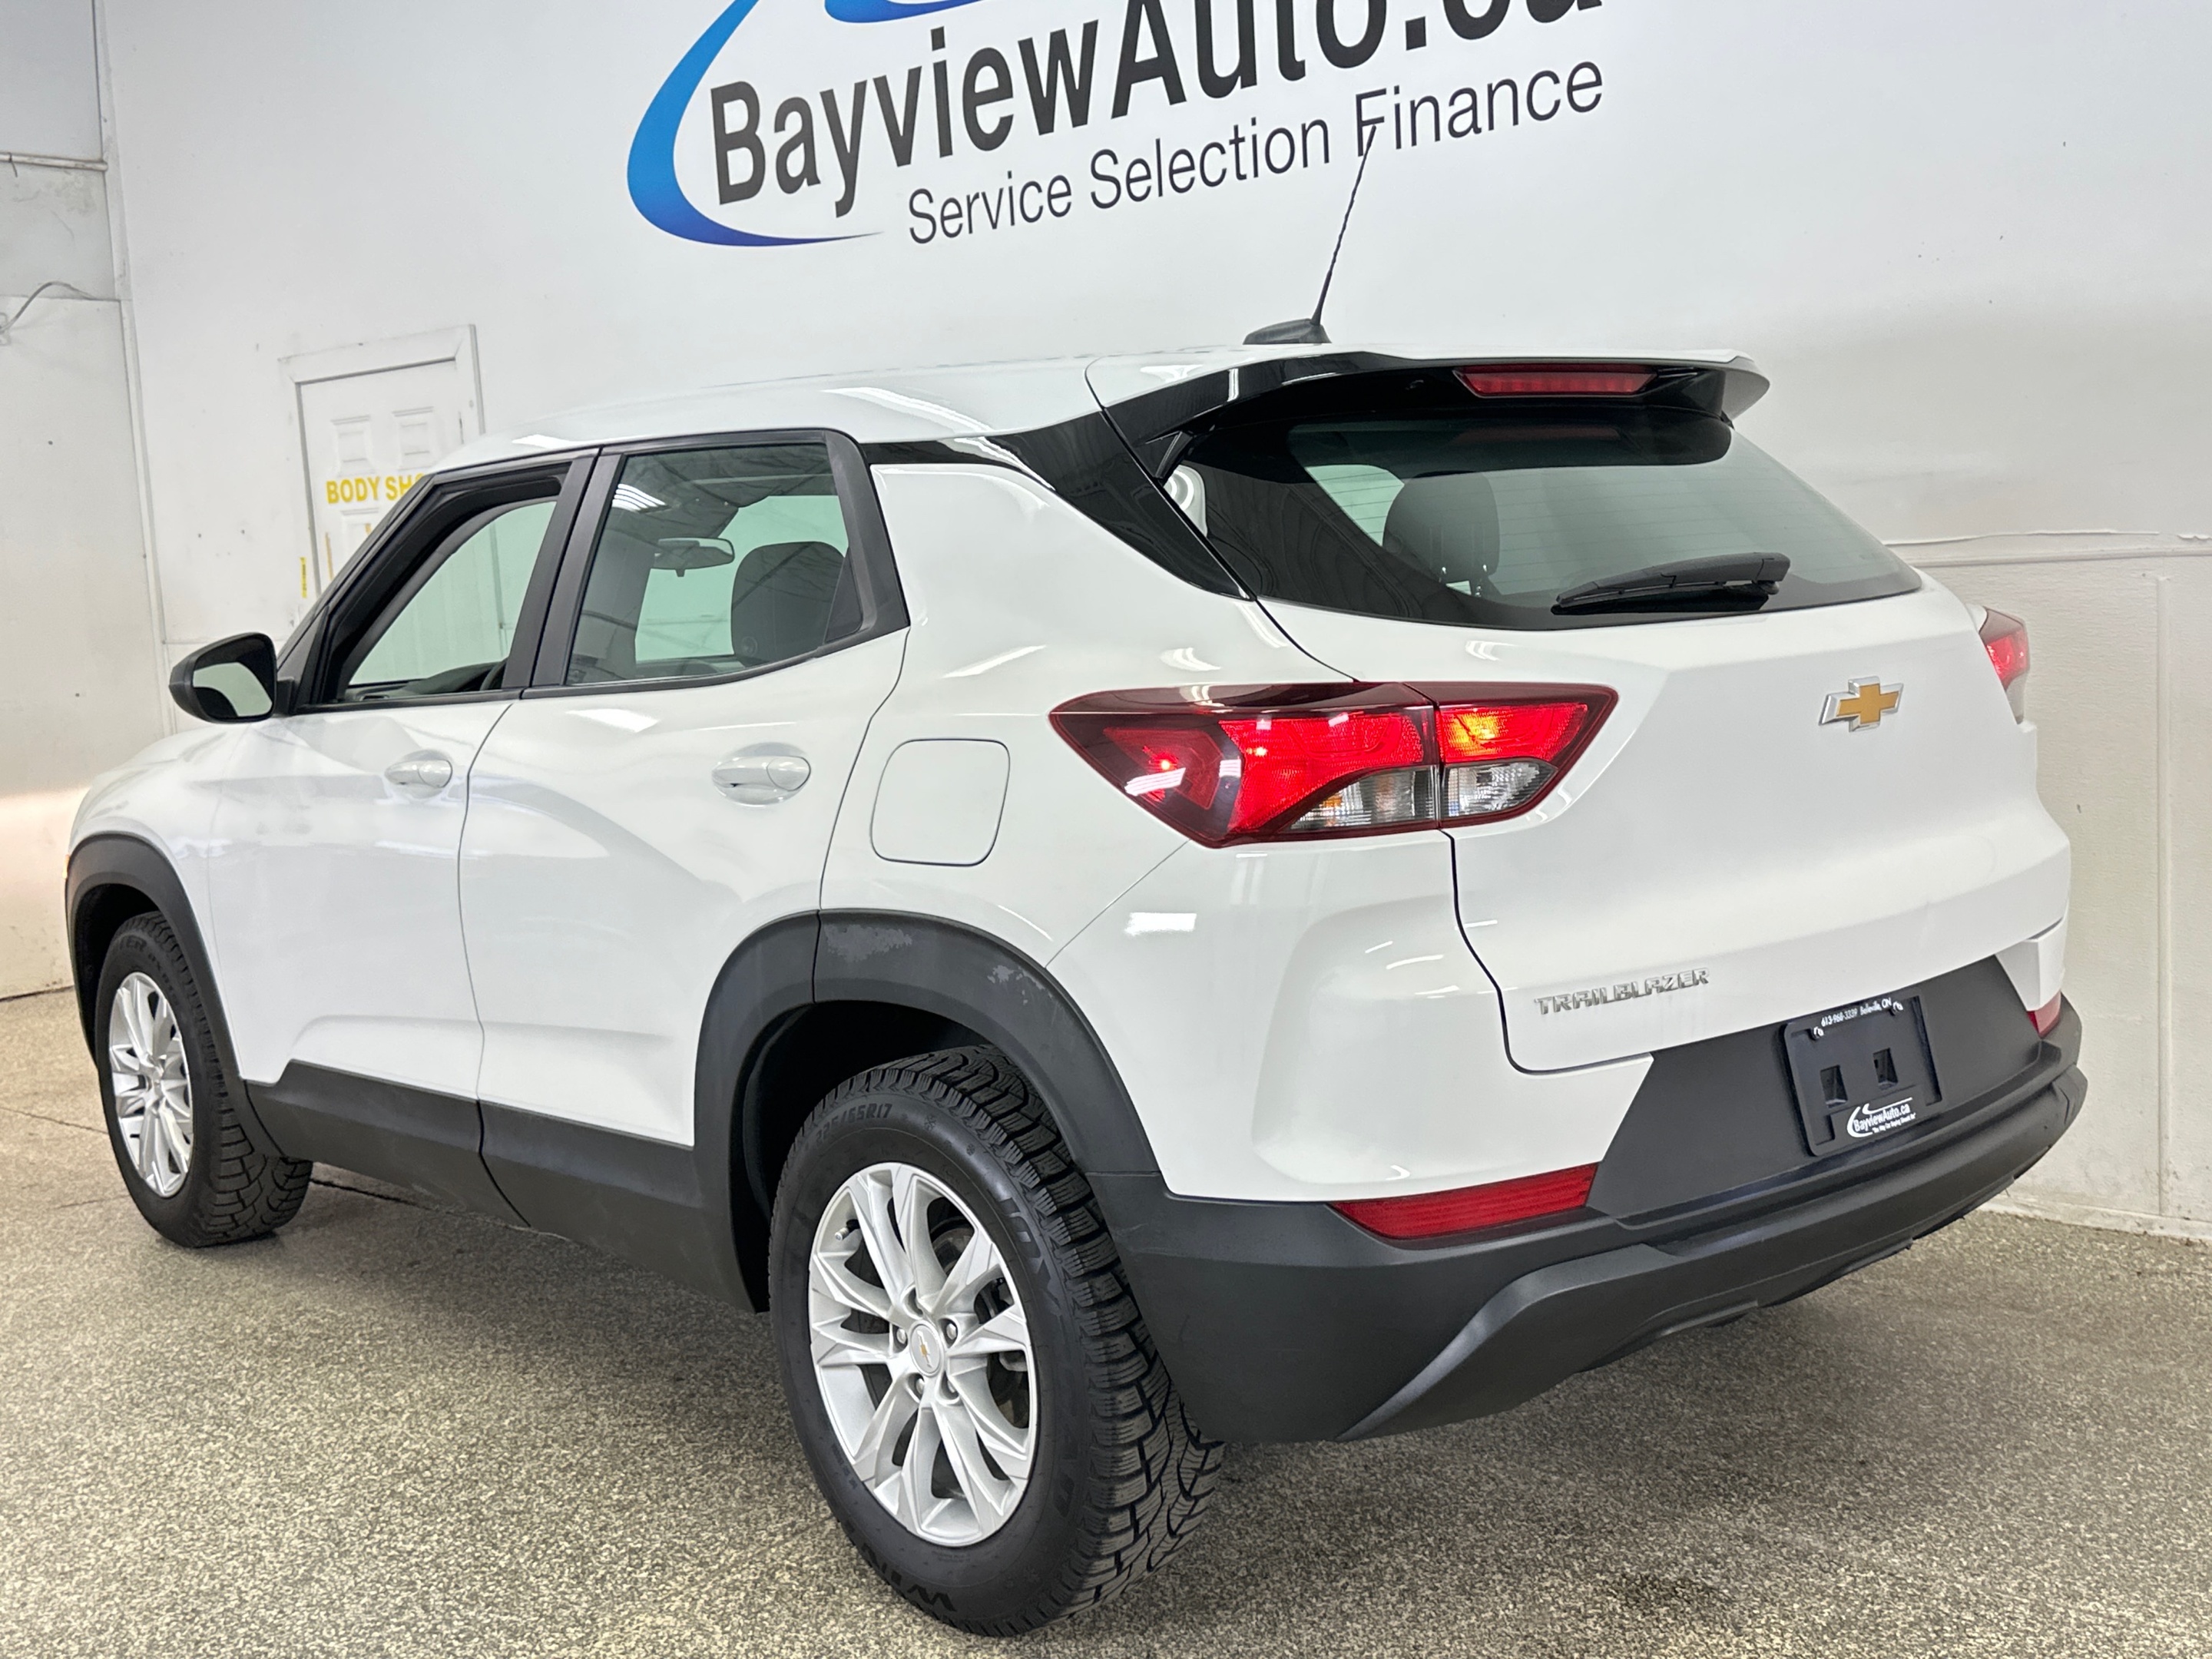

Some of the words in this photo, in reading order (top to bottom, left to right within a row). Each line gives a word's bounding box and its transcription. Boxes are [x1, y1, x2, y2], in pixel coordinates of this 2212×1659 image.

[710, 0, 1602, 218] BayviewAuto.
[909, 170, 1072, 244] Service
[1090, 116, 1330, 210] Selection
[1354, 61, 1604, 158] Finance
[326, 475, 380, 505] BODY
[385, 473, 425, 501] SH
[1534, 967, 1710, 1015] TRAILBLAZER
